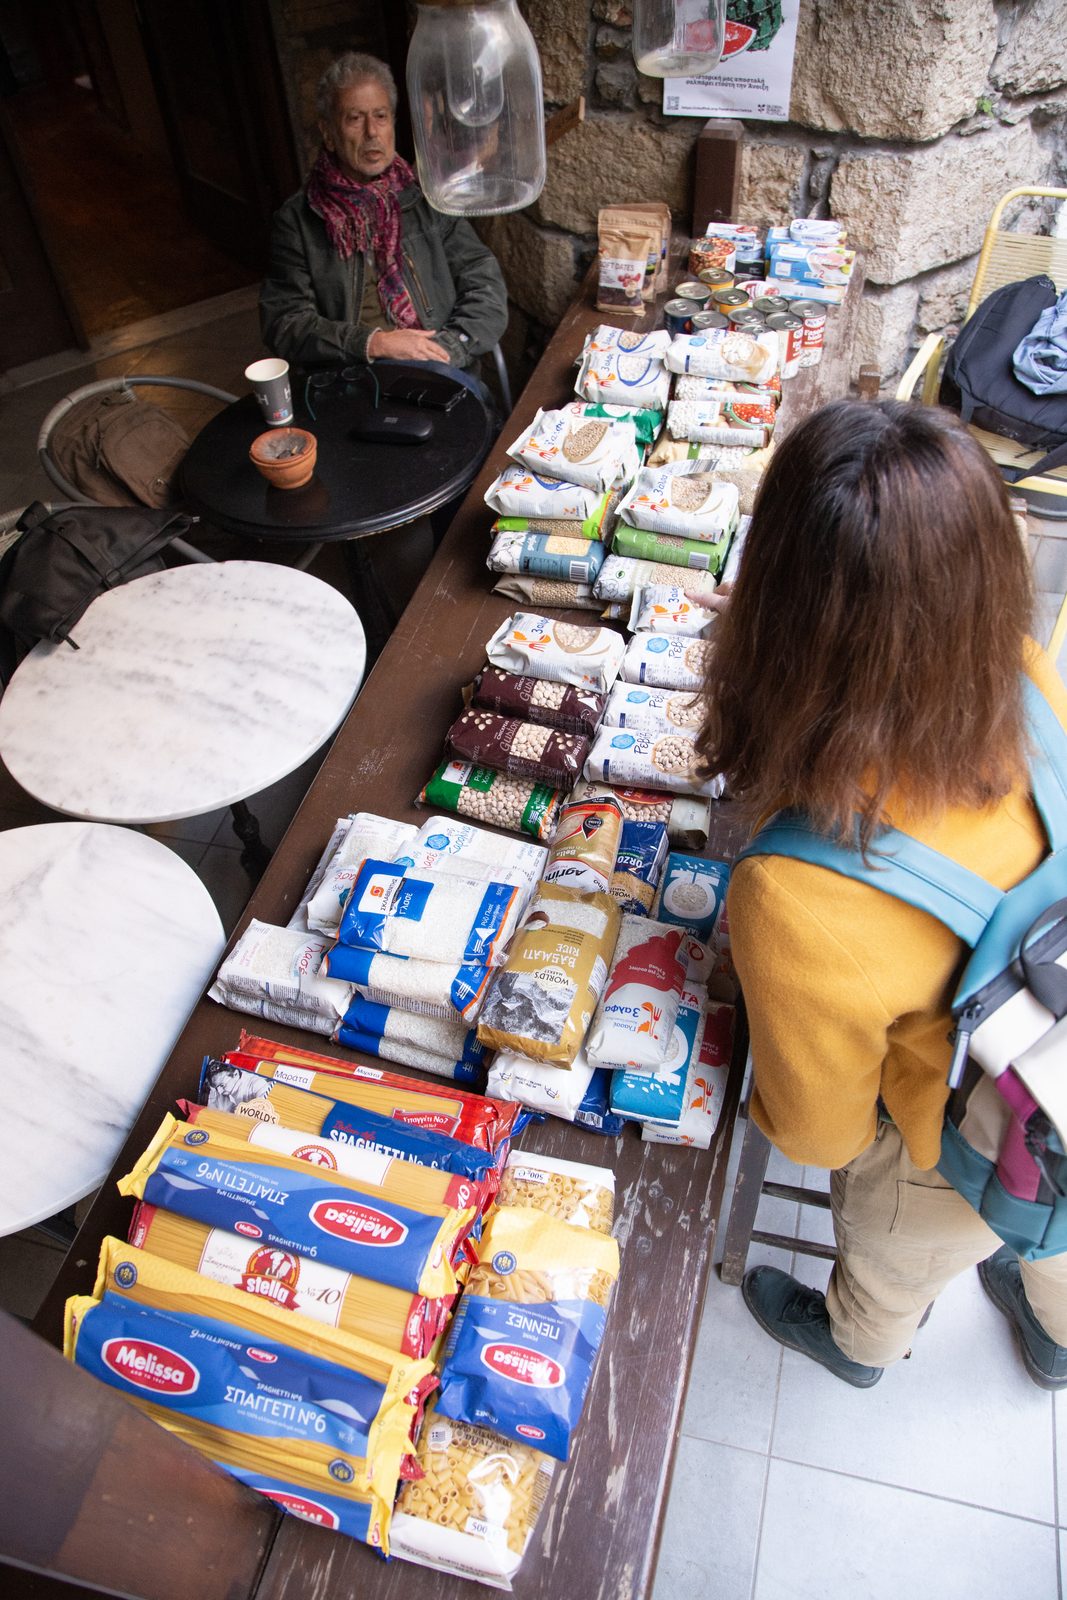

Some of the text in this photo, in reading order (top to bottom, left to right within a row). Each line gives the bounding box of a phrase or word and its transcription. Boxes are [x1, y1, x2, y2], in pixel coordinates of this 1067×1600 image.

[520, 678, 536, 702] Gust
[617, 856, 643, 868] ORZO
[609, 890, 630, 898] WORL
[399, 892, 413, 916] Γλασέ
[523, 948, 576, 968] BASMATI
[556, 943, 580, 957] RICE
[534, 972, 569, 986] WORLD'S
[239, 1106, 277, 1124] WORLD'S
[224, 1172, 289, 1206] ΣΠΑΓΓΕΤΙ
[323, 1206, 392, 1240] Melissa
[268, 1234, 302, 1251] SPAGHETTI
[246, 1277, 290, 1302] stella
[315, 1288, 341, 1305] 10
[505, 1312, 560, 1339] ΠΕΝΝΕΣ
[206, 1334, 242, 1350] SPAGHETTI
[115, 1346, 184, 1385] Melissa
[493, 1350, 552, 1383] Melissa
[256, 1383, 290, 1398] SPAGHETTI
[223, 1385, 296, 1422] ΣΠΑΓΓΕΤΙ
[472, 1524, 488, 1534] 500
